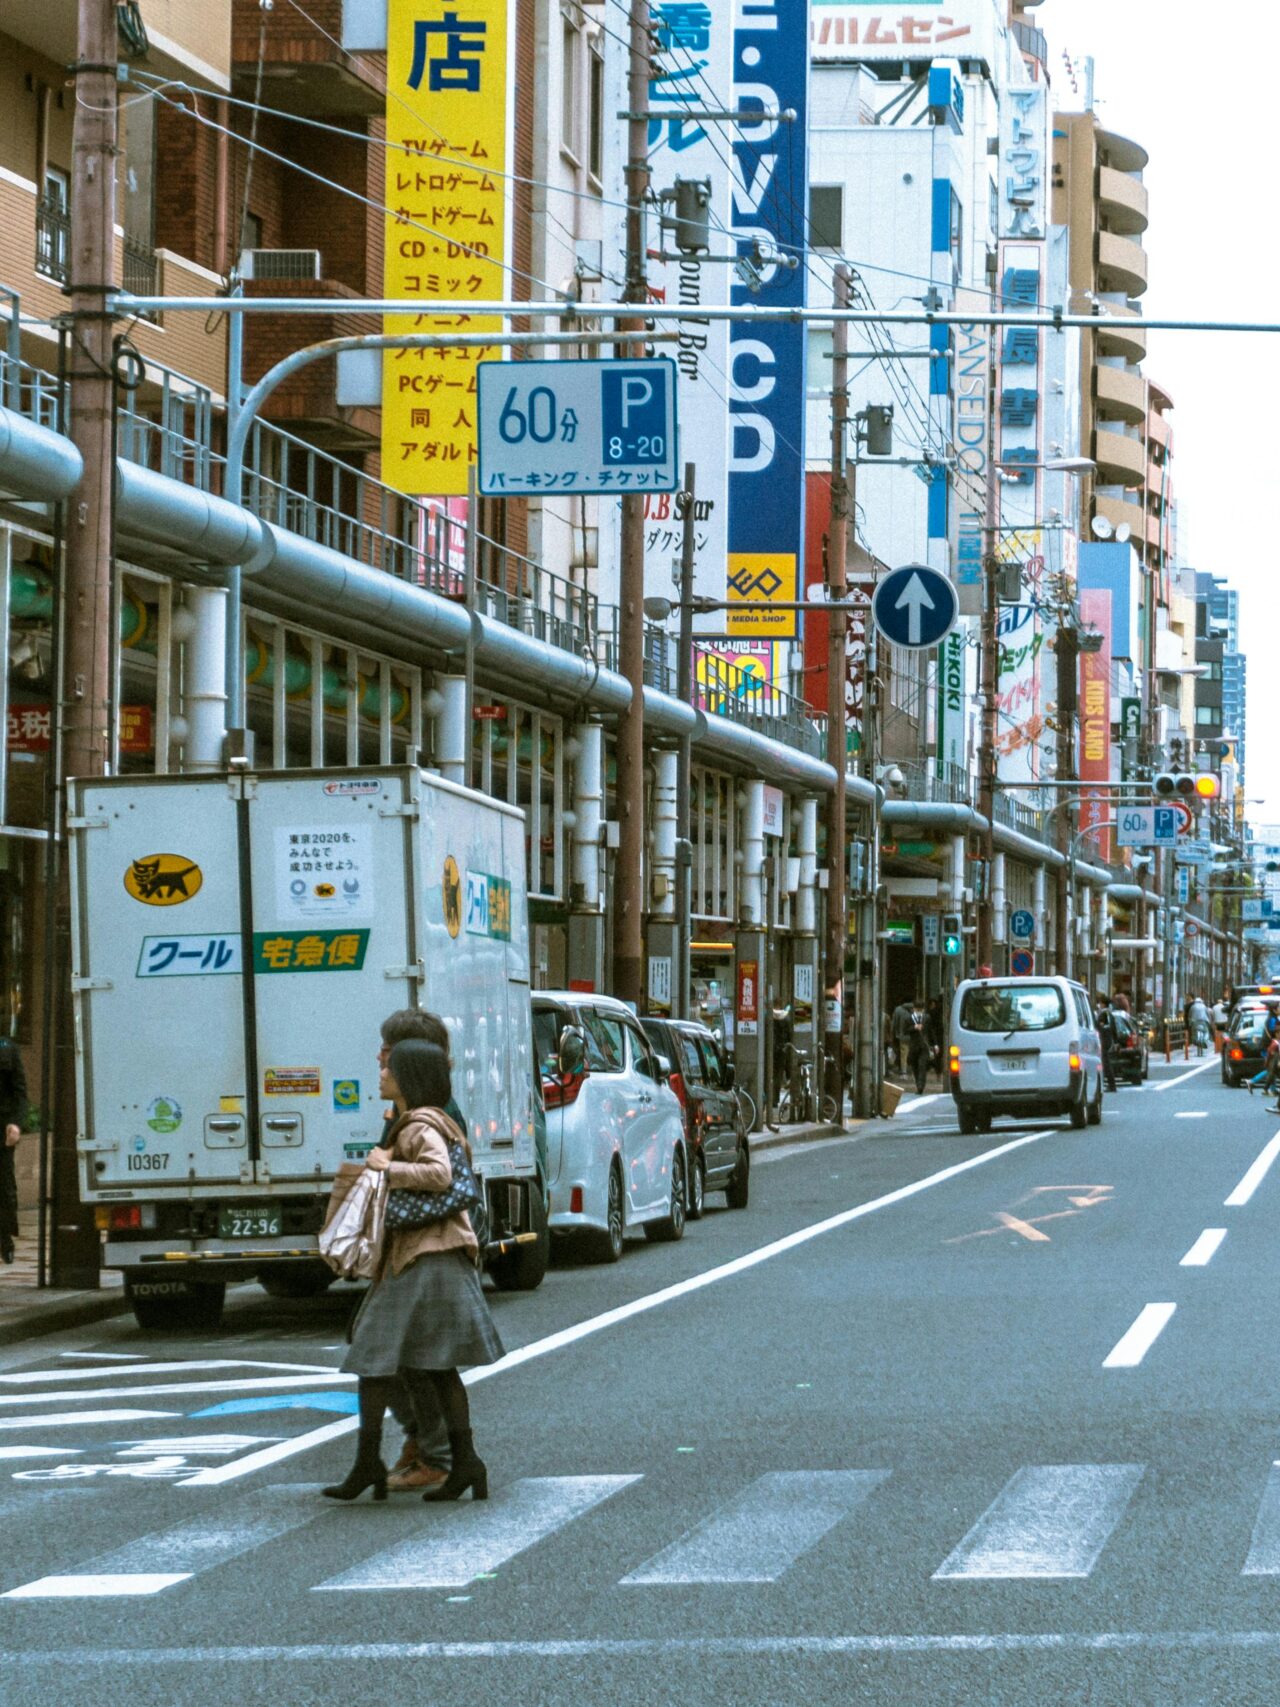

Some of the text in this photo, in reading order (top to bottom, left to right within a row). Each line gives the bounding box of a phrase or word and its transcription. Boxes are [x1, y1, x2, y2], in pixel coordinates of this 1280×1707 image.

[407, 11, 486, 92] 店
[402, 139, 488, 158] TVゲーム
[396, 172, 496, 192] レトロゲーム
[394, 206, 495, 227] カードゲーム
[403, 274, 484, 293] コミック
[621, 376, 653, 429] P
[498, 385, 579, 444] 60分
[400, 441, 479, 462] アダルト
[609, 436, 664, 459] 8-20
[731, 615, 787, 623] MEDIA SHOP
[1085, 680, 1104, 717] KIDS
[1085, 719, 1104, 761] LAND
[1159, 811, 1171, 827] P
[289, 847, 332, 859] みんなで
[148, 934, 360, 973] クール 宅急便
[232, 1219, 279, 1236] 22-96
[131, 1283, 187, 1296] TOYOTA
